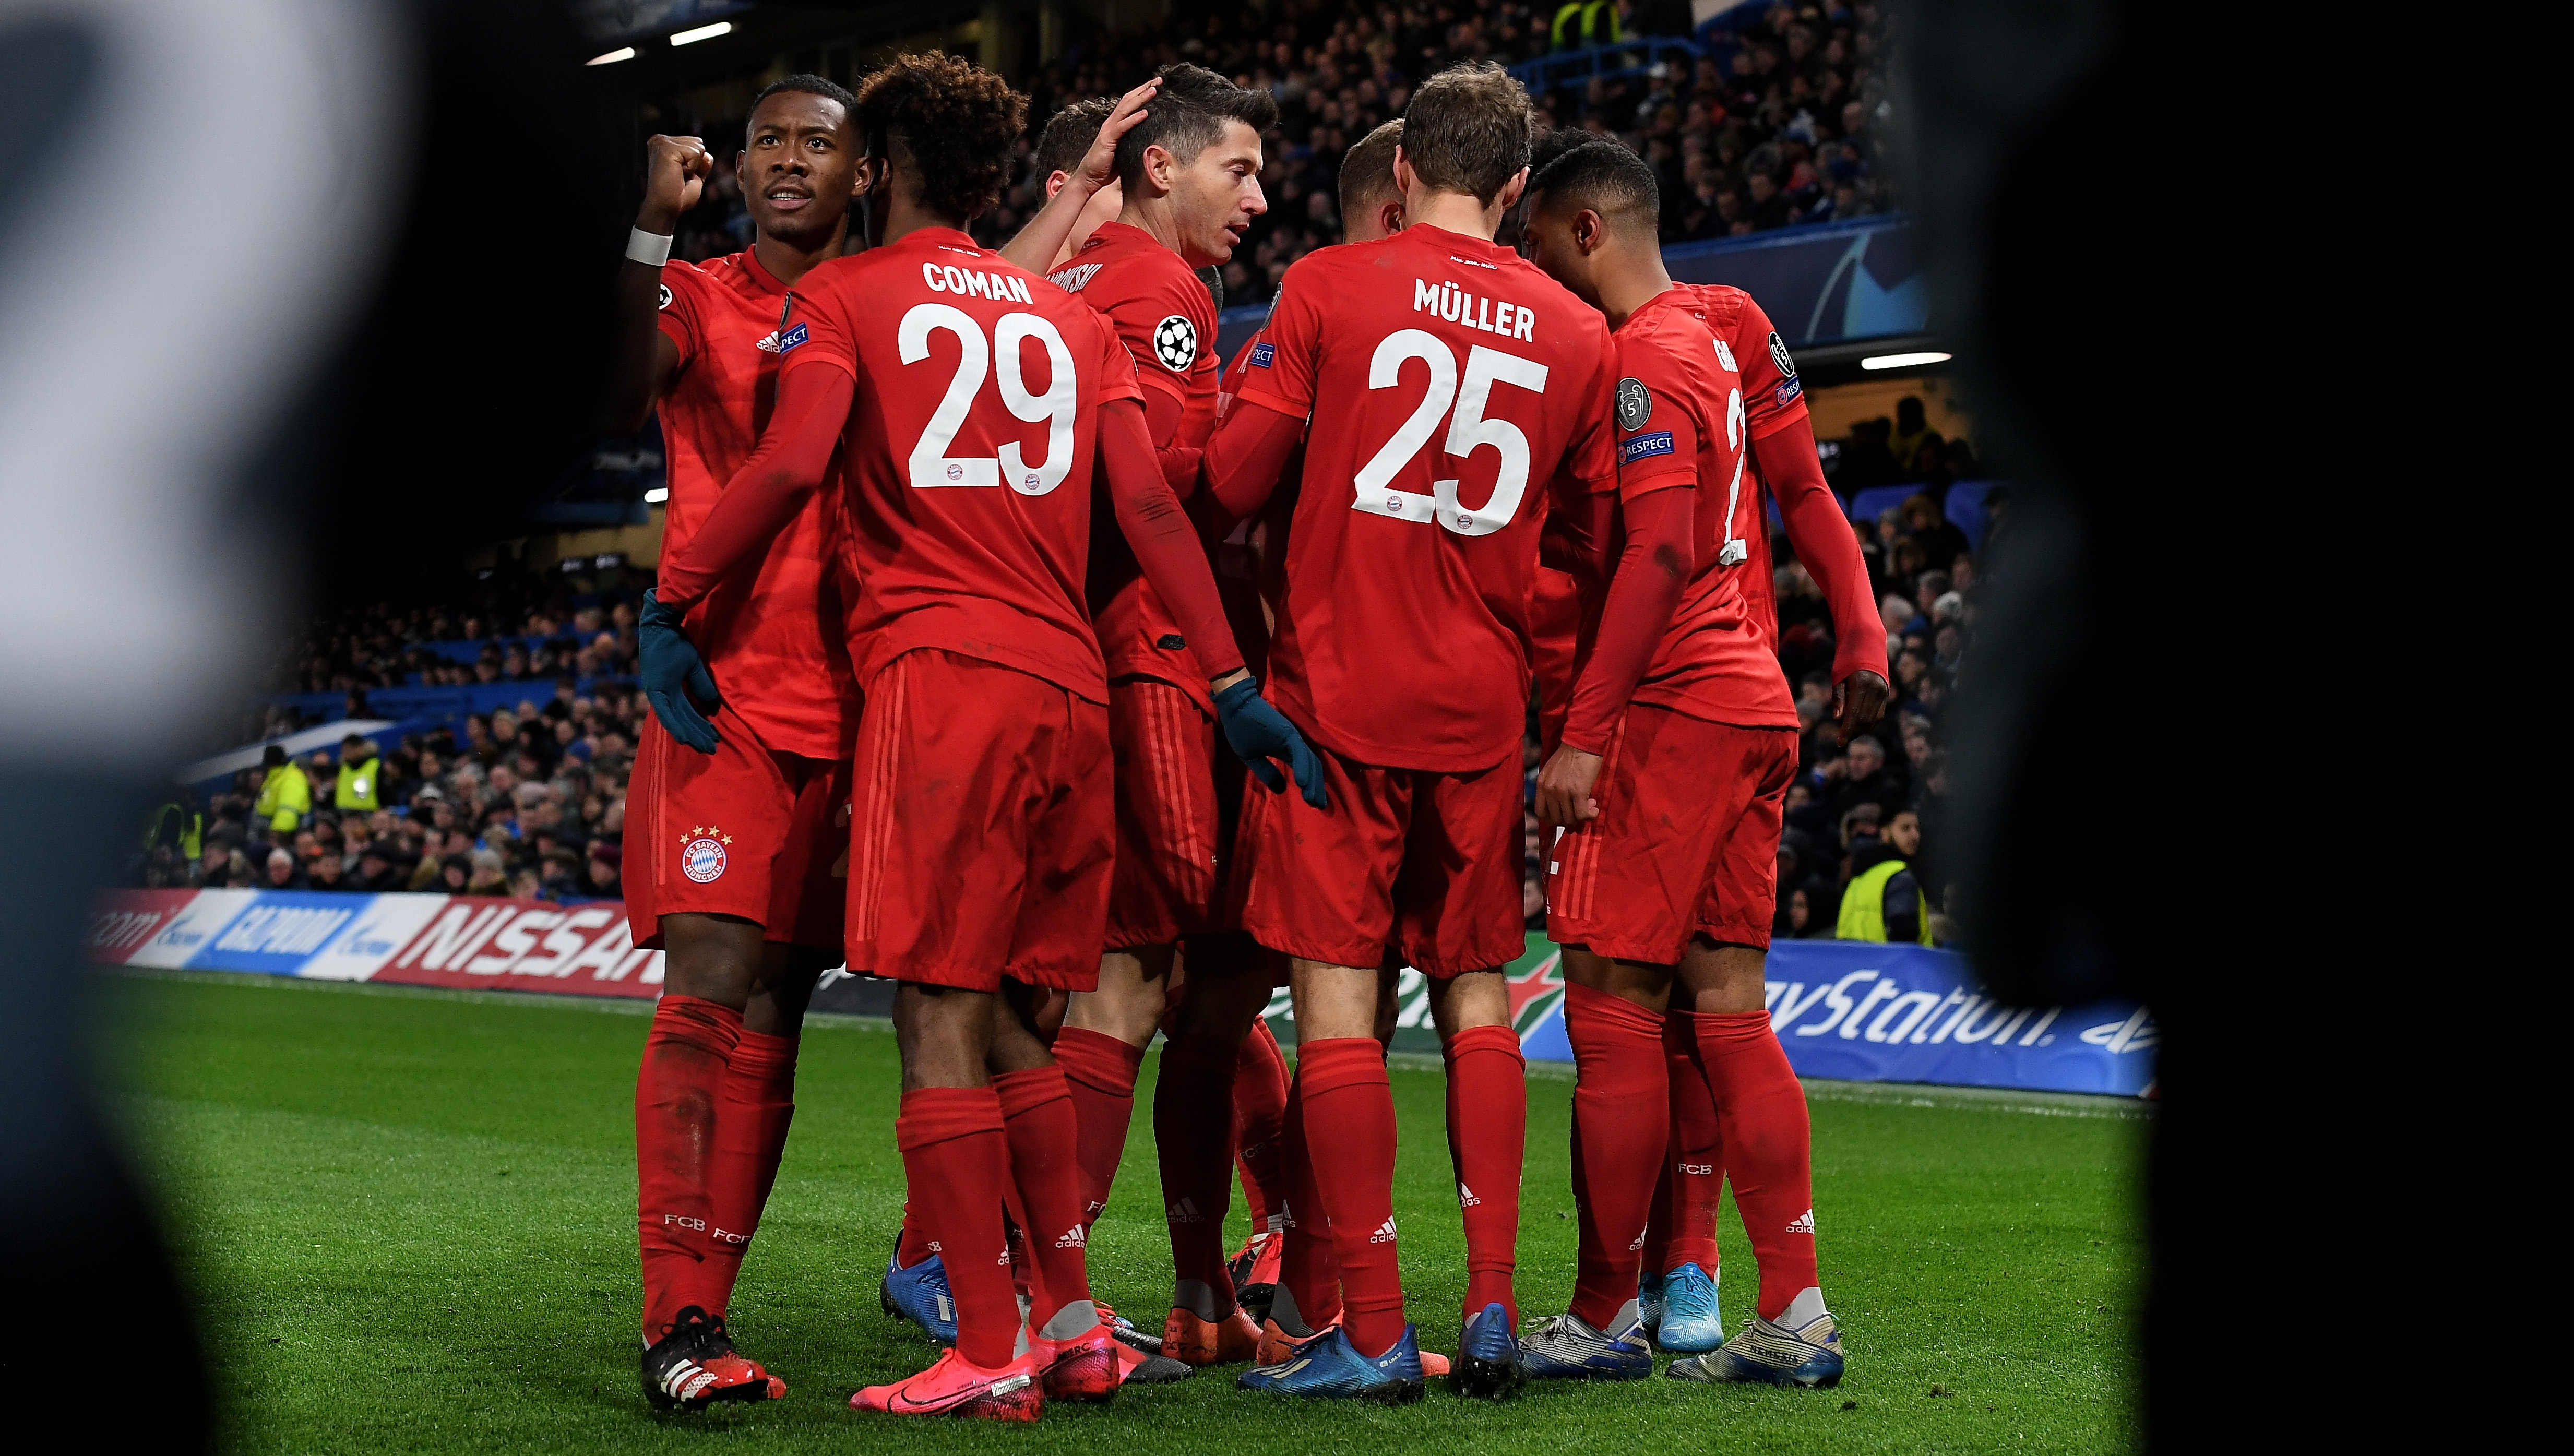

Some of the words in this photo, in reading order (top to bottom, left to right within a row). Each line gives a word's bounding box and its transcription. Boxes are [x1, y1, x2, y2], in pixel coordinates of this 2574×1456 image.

[922, 262, 1034, 305] COMAN
[1413, 278, 1535, 343] MÜLLER
[1780, 352, 1788, 365] 5
[898, 303, 1077, 496] 29
[1627, 402, 1636, 416] 5
[1351, 329, 1550, 536] 25
[1626, 437, 1672, 456] RESPECT
[695, 842, 723, 858] BAYERN
[1678, 1163, 1712, 1175] FCB
[664, 1214, 706, 1231] FCB
[1370, 1232, 1397, 1244] adid
